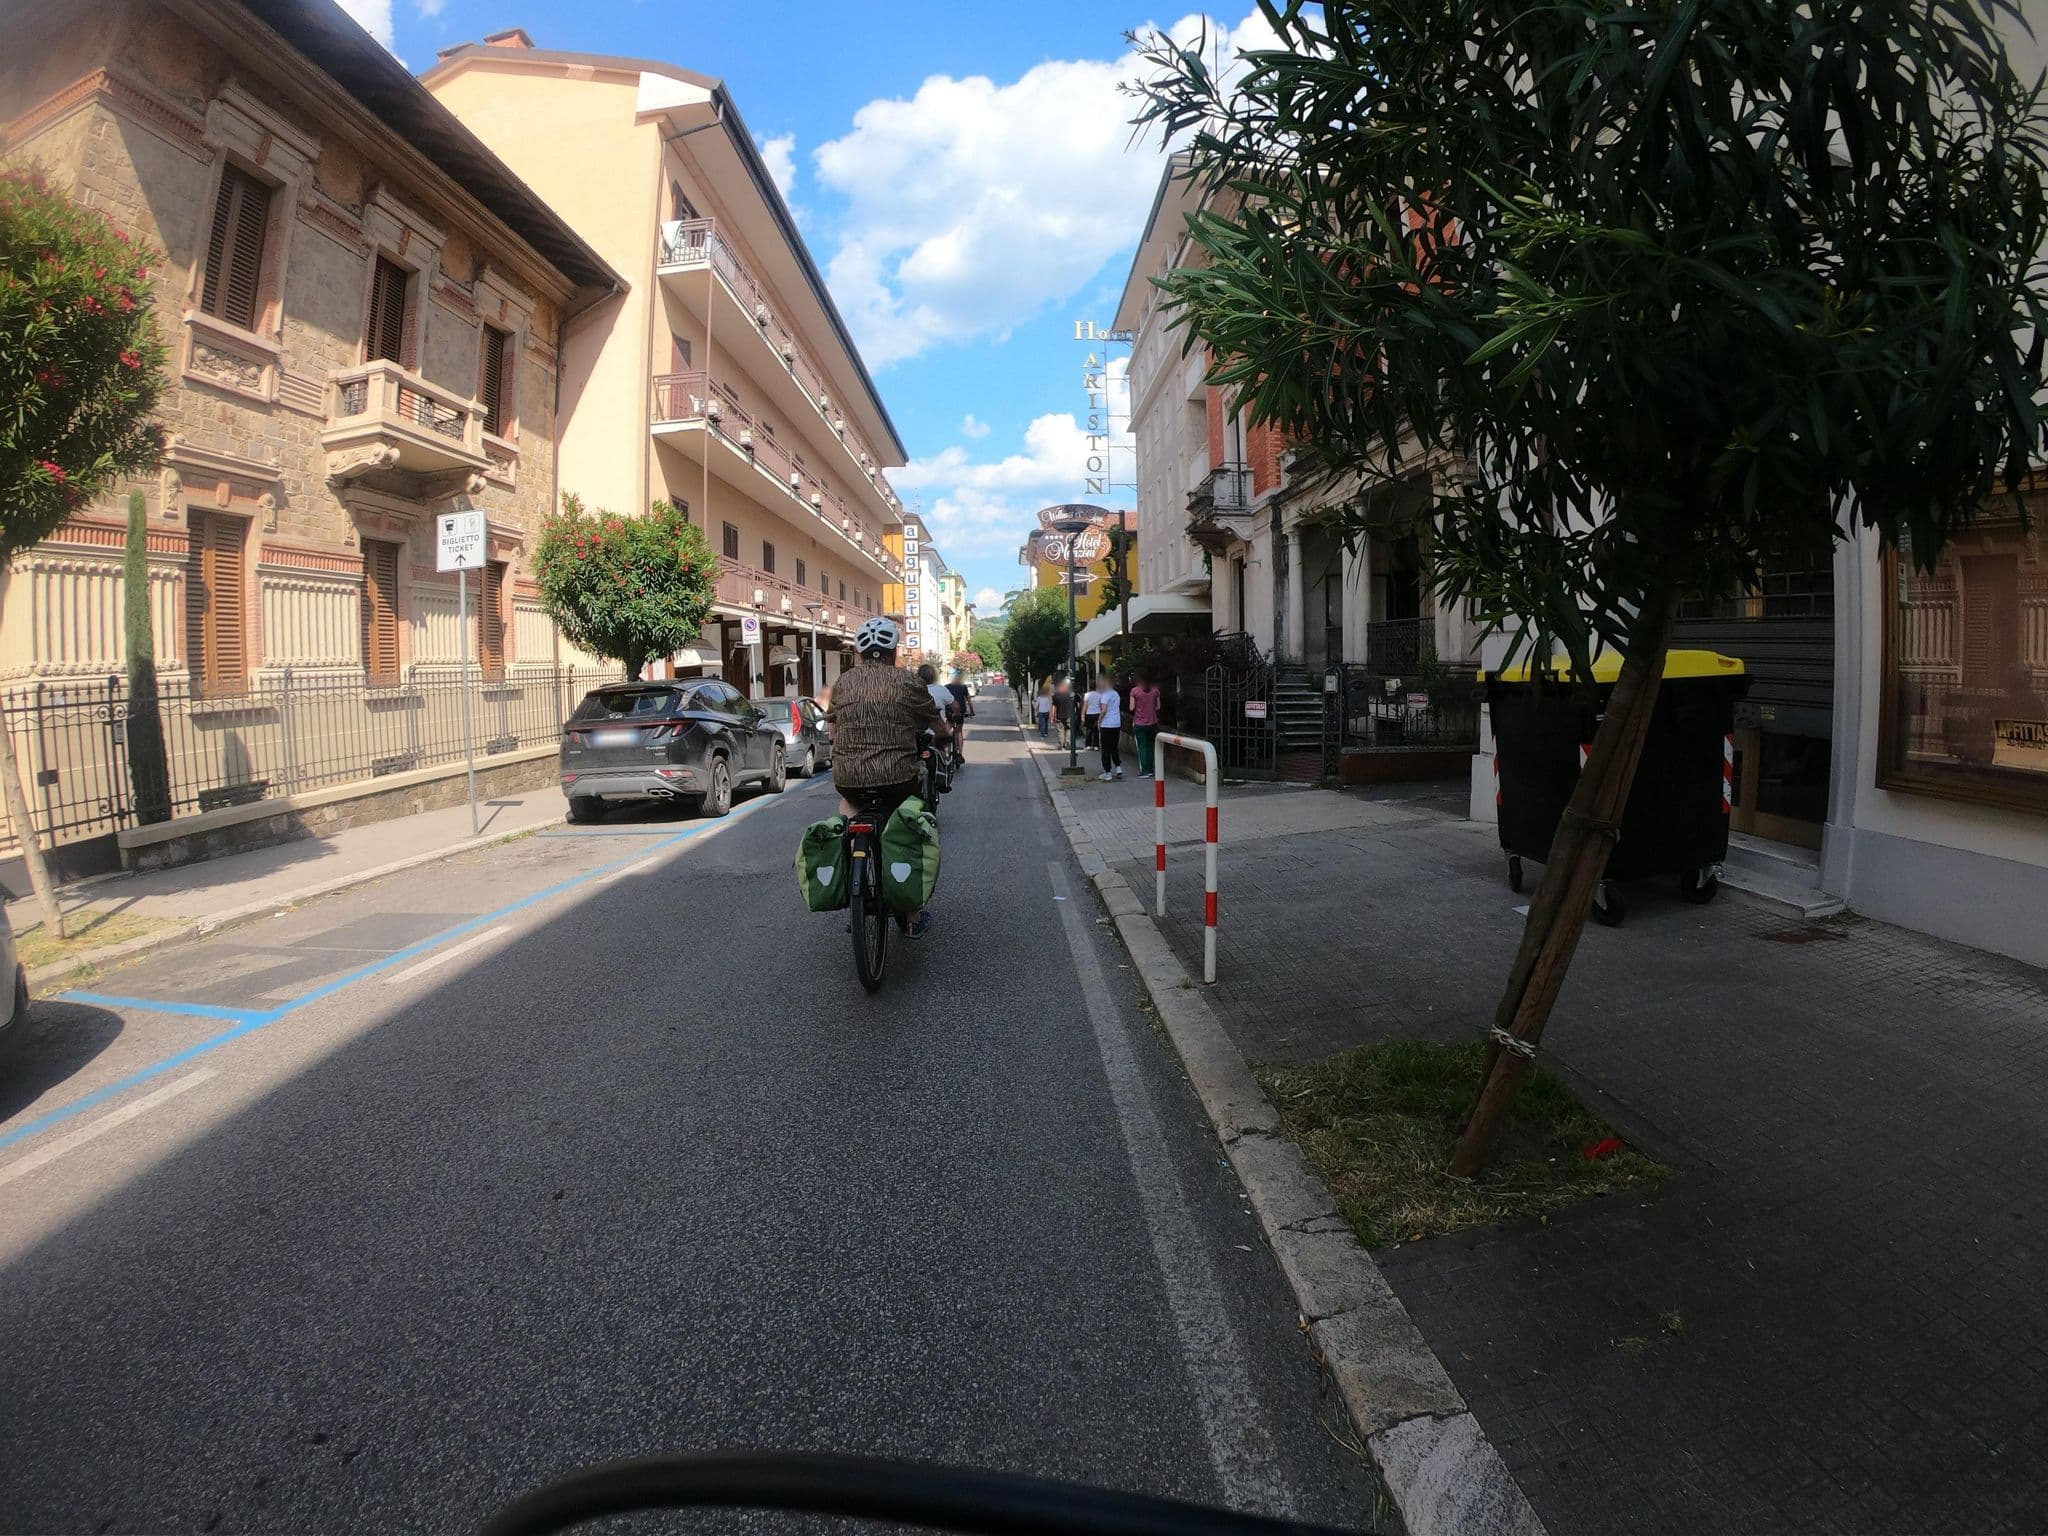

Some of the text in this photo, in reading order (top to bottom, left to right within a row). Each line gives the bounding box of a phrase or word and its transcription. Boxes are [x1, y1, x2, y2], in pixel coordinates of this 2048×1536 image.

[1083, 352, 1104, 494] ARISTON
[442, 534, 480, 545] BIGLIETTO
[448, 543, 474, 553] TICKET
[907, 527, 918, 647] augustus
